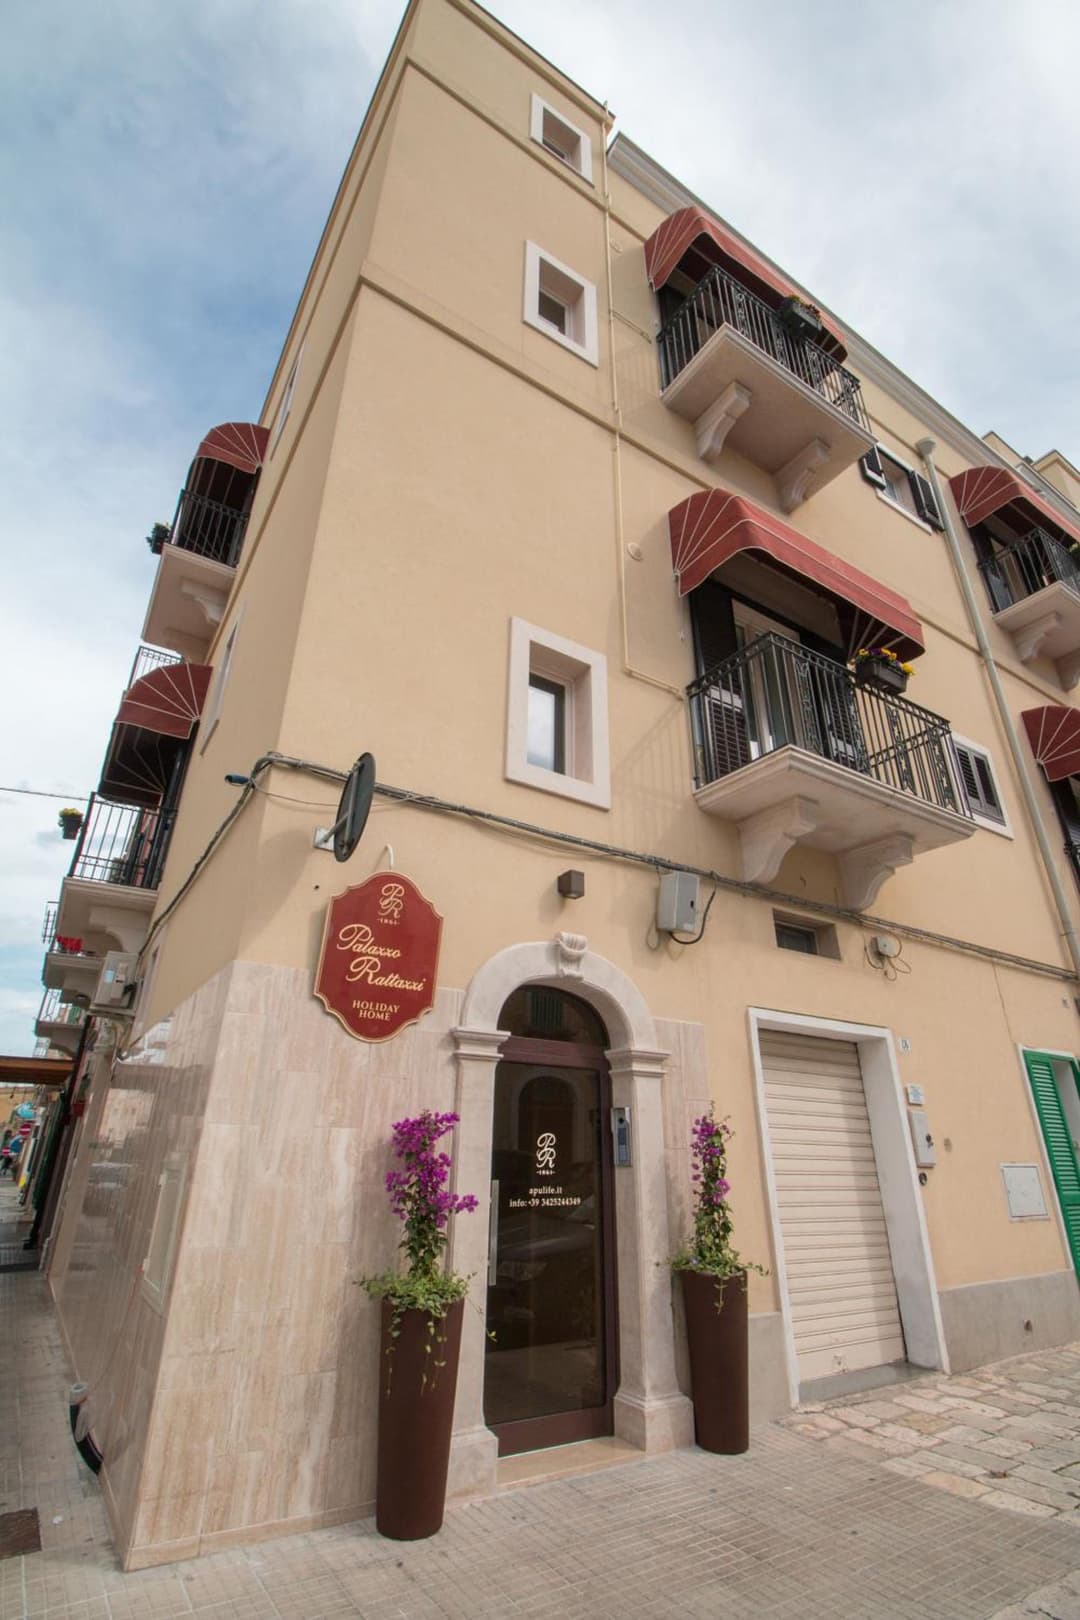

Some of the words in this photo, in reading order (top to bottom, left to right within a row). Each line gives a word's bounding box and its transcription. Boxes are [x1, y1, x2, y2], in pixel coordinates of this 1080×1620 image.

[337, 924, 401, 959] Palazzo
[345, 956, 426, 991] Rattazzi
[352, 1000, 400, 1013] HOLIDAY
[359, 1010, 391, 1021] HOME
[509, 1198, 528, 1208] info:
